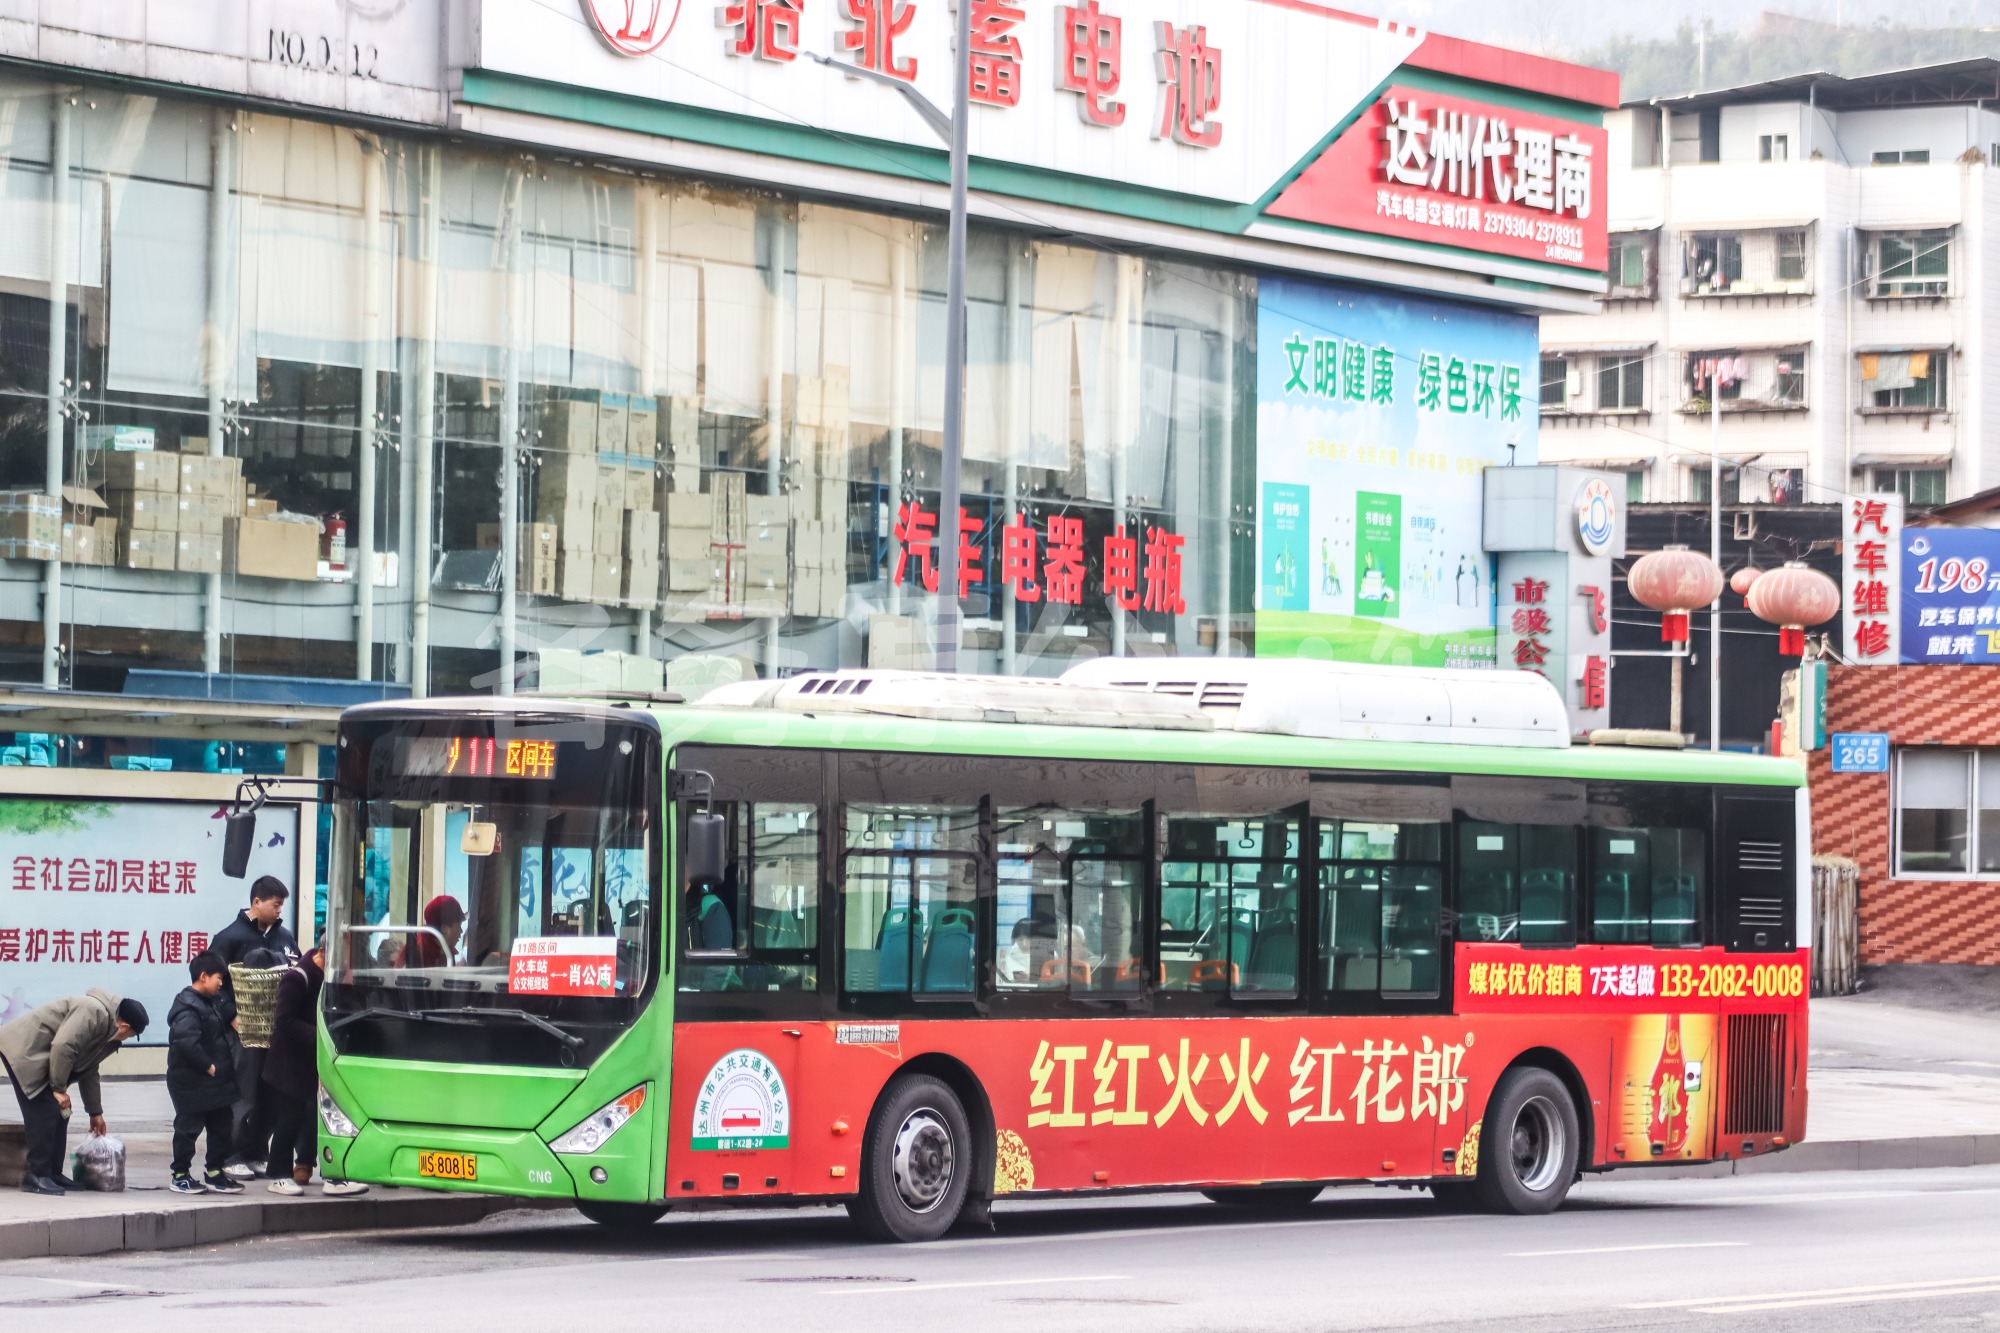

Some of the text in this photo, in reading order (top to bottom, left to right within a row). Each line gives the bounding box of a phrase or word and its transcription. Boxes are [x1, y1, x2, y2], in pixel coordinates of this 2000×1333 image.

[1385, 97, 1593, 219] 达州代理商
[1376, 190, 1583, 249] 汽车电器空调灯具 2379304 2378911
[1283, 334, 1521, 421] 文明健康 绿色环保
[893, 500, 1186, 615] 汽车 电器 电瓶
[1853, 499, 1890, 658] 汽车维修
[1510, 577, 1552, 681] 市级公
[1919, 606, 2000, 626] 汽车保养
[1577, 584, 1607, 737] 飞信
[506, 740, 556, 777] 区间车
[1841, 747, 1879, 765] 265
[12, 855, 198, 895] 全社会动员起来
[515, 959, 548, 974] 火车站
[517, 942, 558, 955] 11路区间
[513, 976, 549, 991] 公交枢纽站
[569, 963, 612, 987] 肖公庙
[1468, 963, 1803, 997] 媒体优价招商 7天起做 133-2082-0008
[698, 1053, 784, 1137] 达州市公共交通有限公司
[1027, 1035, 1466, 1129] 红红火火 红花郎
[528, 1169, 553, 1184] CNG
